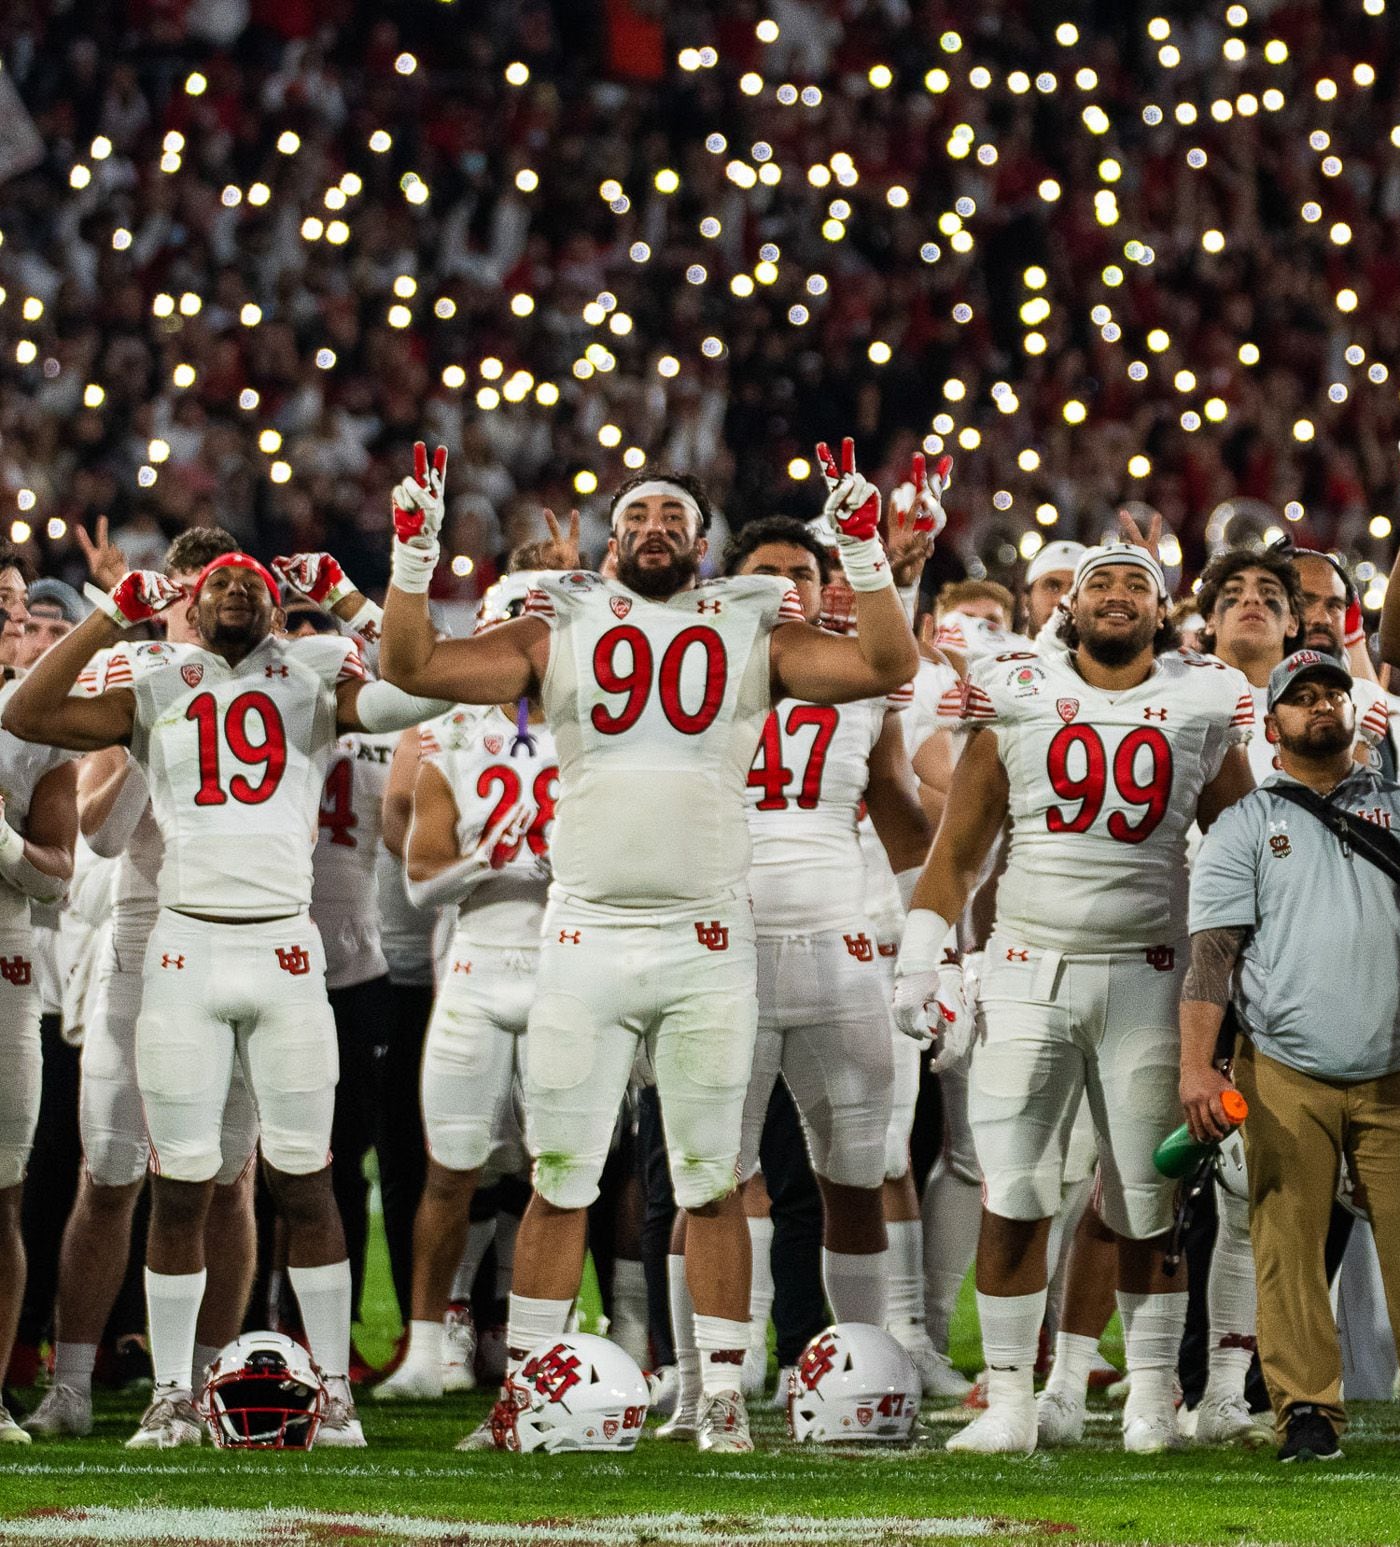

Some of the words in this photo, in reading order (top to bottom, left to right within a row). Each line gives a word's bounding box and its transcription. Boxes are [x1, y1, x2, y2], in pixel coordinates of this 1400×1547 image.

[591, 624, 727, 735] 90
[185, 690, 287, 806] 19
[746, 704, 840, 812] 47
[1046, 722, 1174, 844] 99
[876, 1393, 906, 1418] 47
